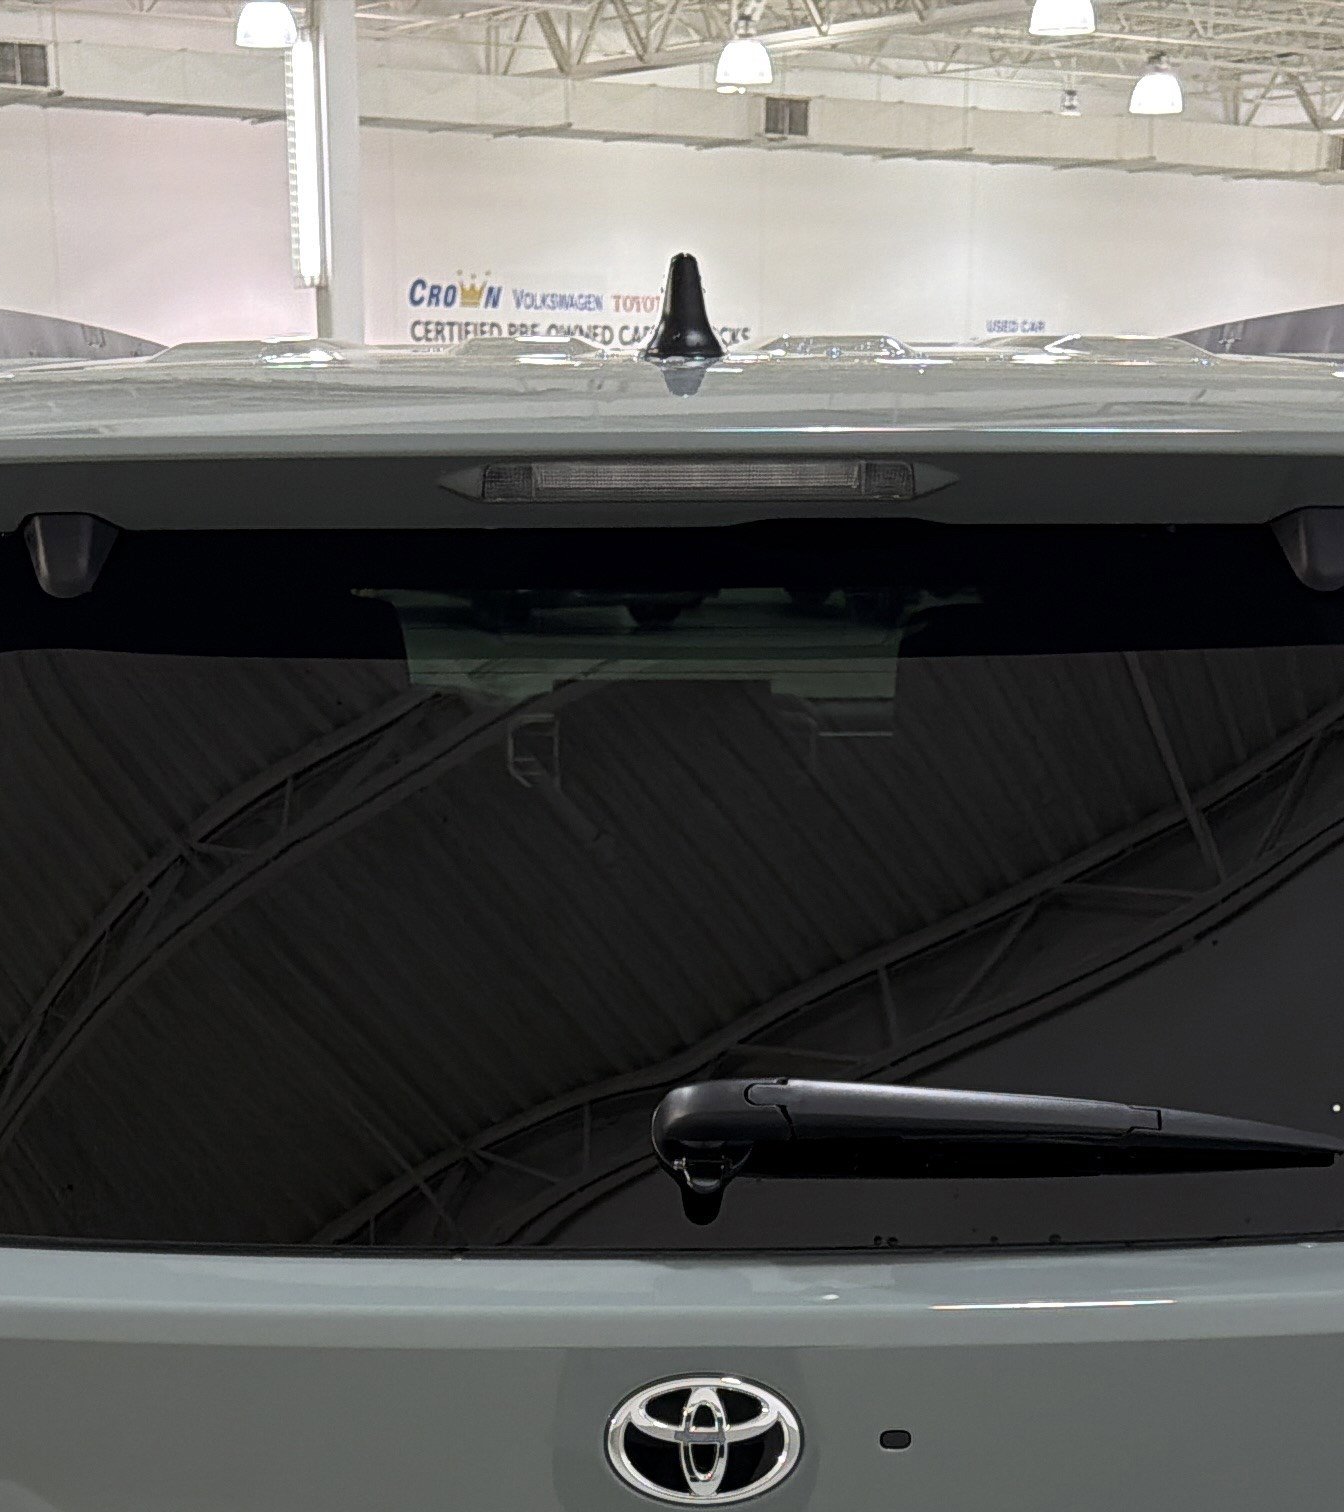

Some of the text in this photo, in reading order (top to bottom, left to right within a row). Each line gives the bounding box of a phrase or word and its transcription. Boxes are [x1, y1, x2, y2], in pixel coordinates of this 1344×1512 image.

[409, 269, 660, 312] CROWN VOLKSWAGEN TOYOT
[410, 320, 503, 342] CERTIFIED
